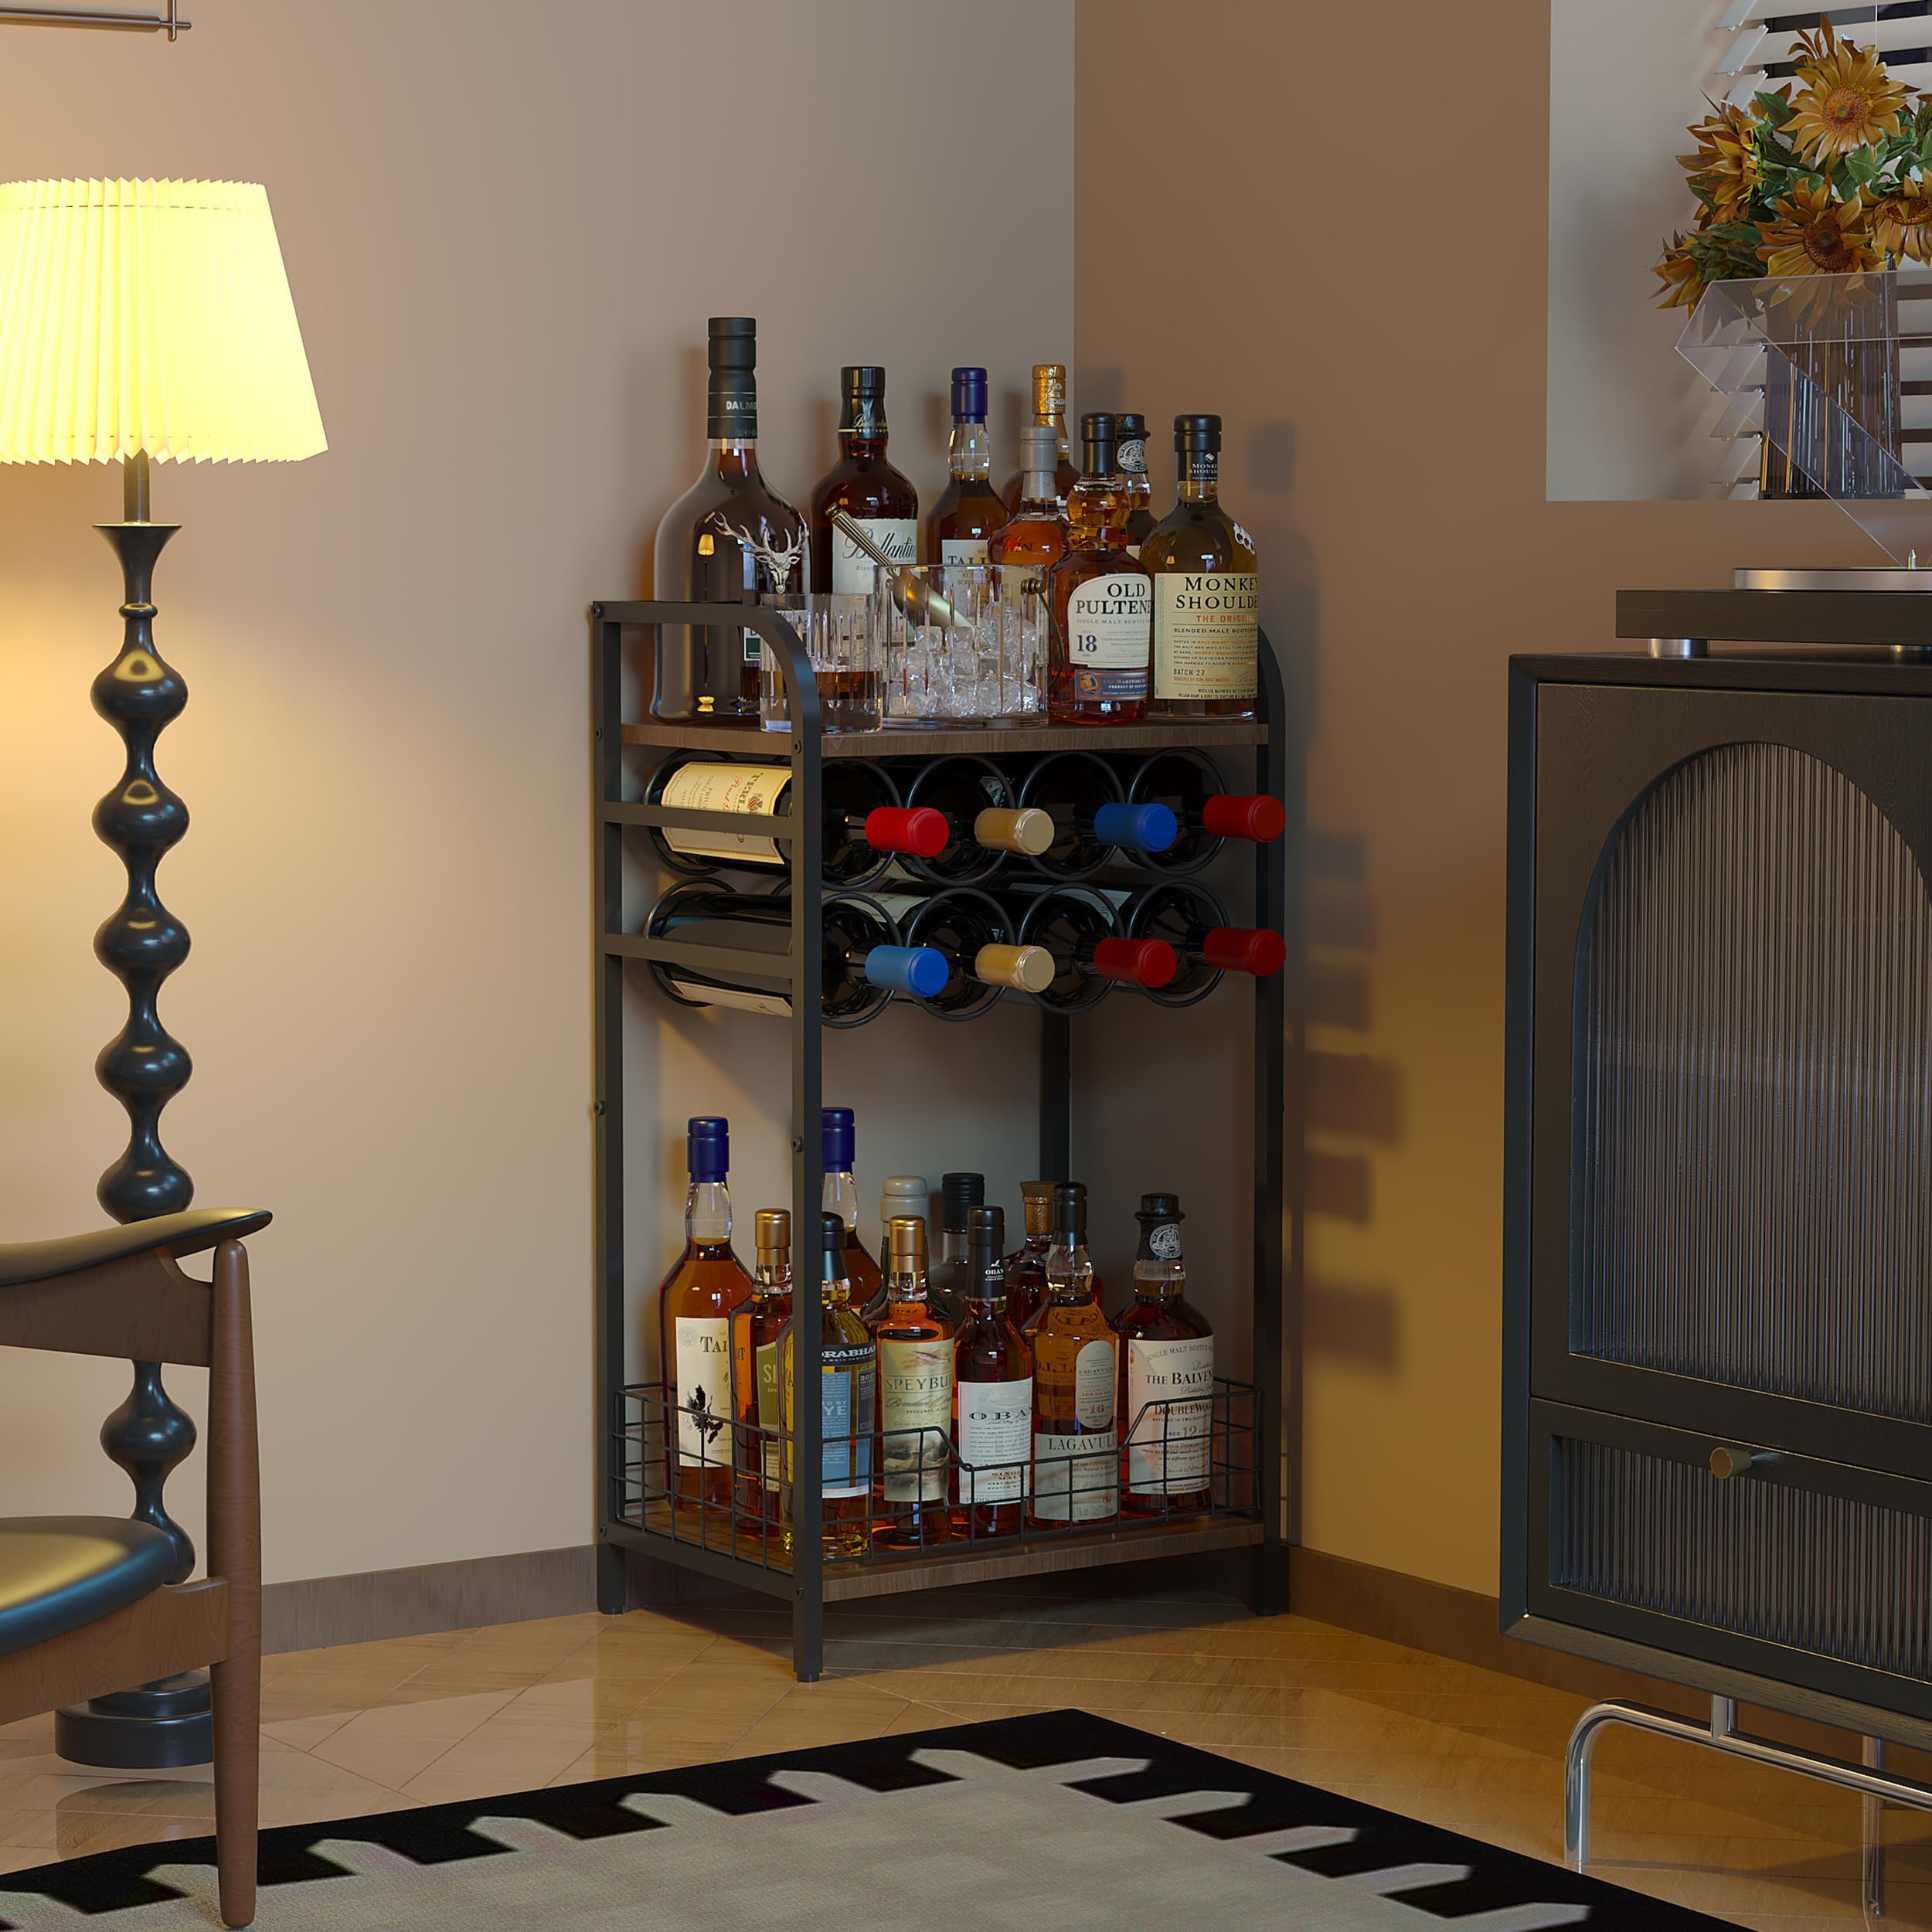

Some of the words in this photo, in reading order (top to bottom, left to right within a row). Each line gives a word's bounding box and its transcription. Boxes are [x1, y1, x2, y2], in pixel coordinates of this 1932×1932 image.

[842, 527, 917, 559] Bllantin
[1107, 583, 1145, 597] OLD
[1077, 634, 1097, 652] 18
[1169, 1346, 1188, 1355] MALT
[1146, 1374, 1168, 1384] THE
[969, 1406, 1032, 1420] OBA
[1090, 1404, 1105, 1413] 16
[1182, 1425, 1197, 1437] 12
